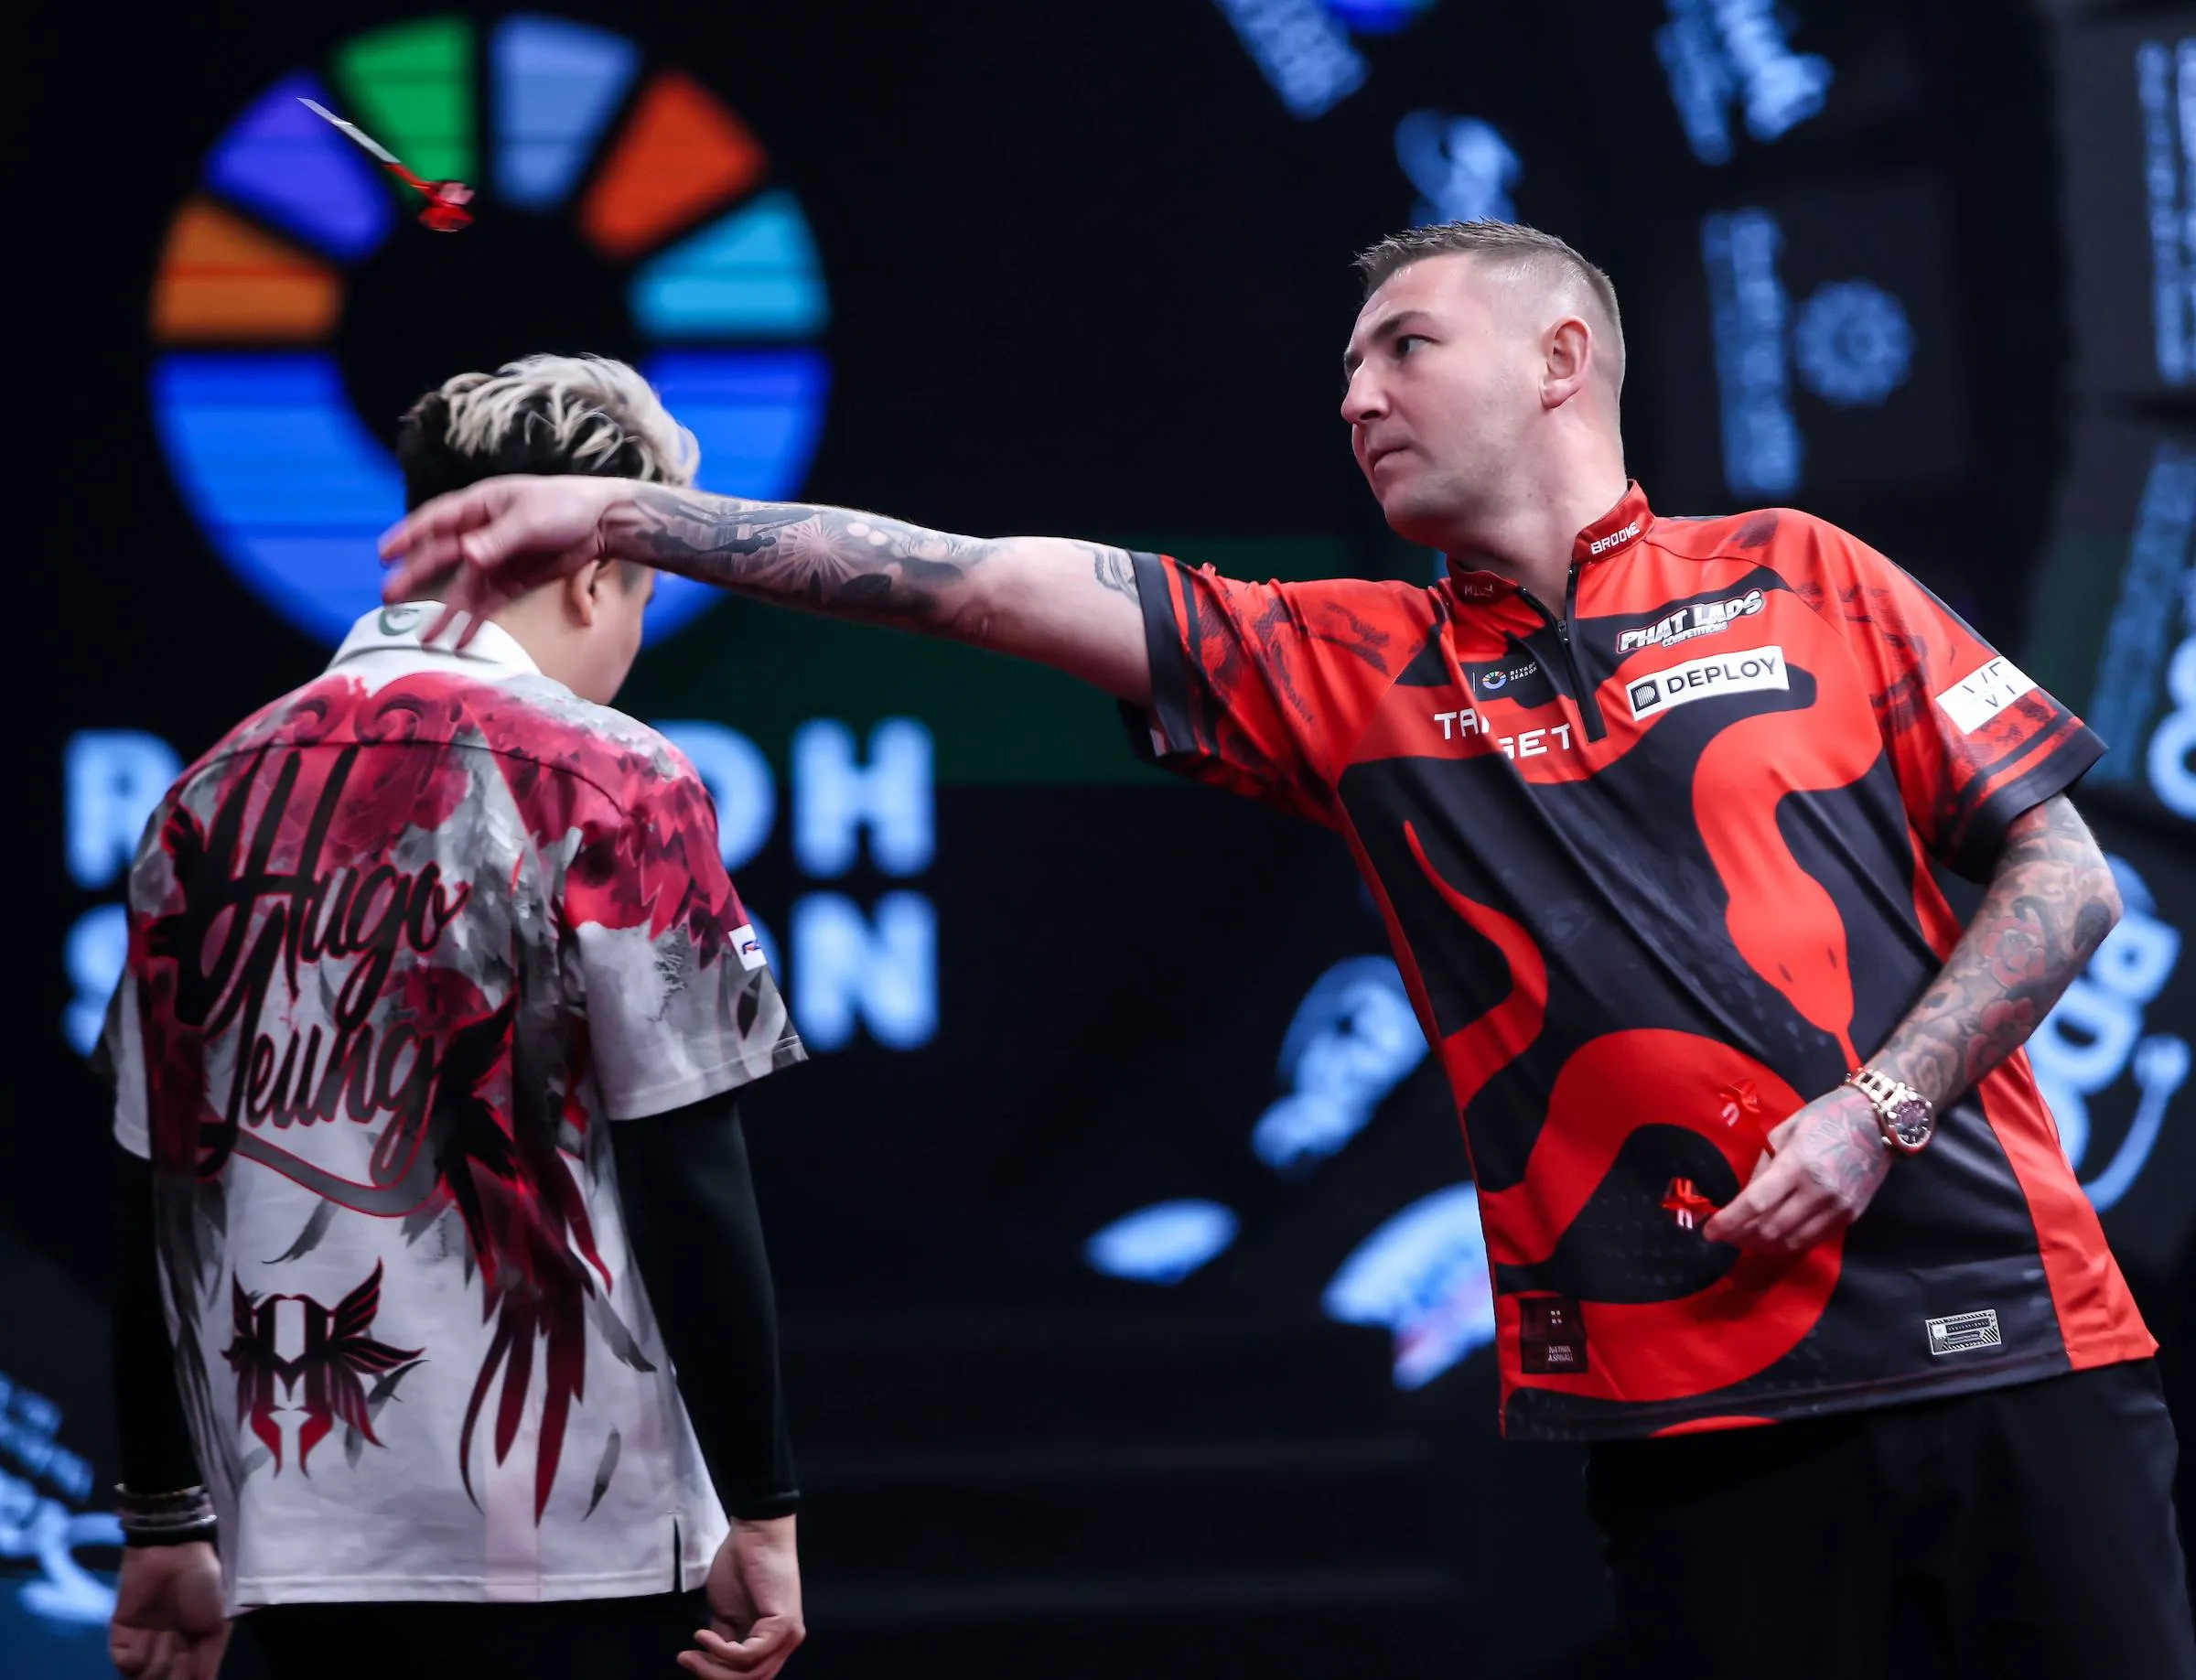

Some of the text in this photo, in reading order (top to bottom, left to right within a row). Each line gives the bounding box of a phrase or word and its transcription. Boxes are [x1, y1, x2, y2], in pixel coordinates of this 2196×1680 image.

[1589, 521, 1641, 555] BROOKE
[1619, 589, 1764, 652] PHAT LADS
[1662, 620, 1728, 648] COMPETITIONS
[1665, 656, 1777, 695] DEPLOY
[1434, 707, 1571, 760] TAGET
[175, 739, 470, 1029] Hugo
